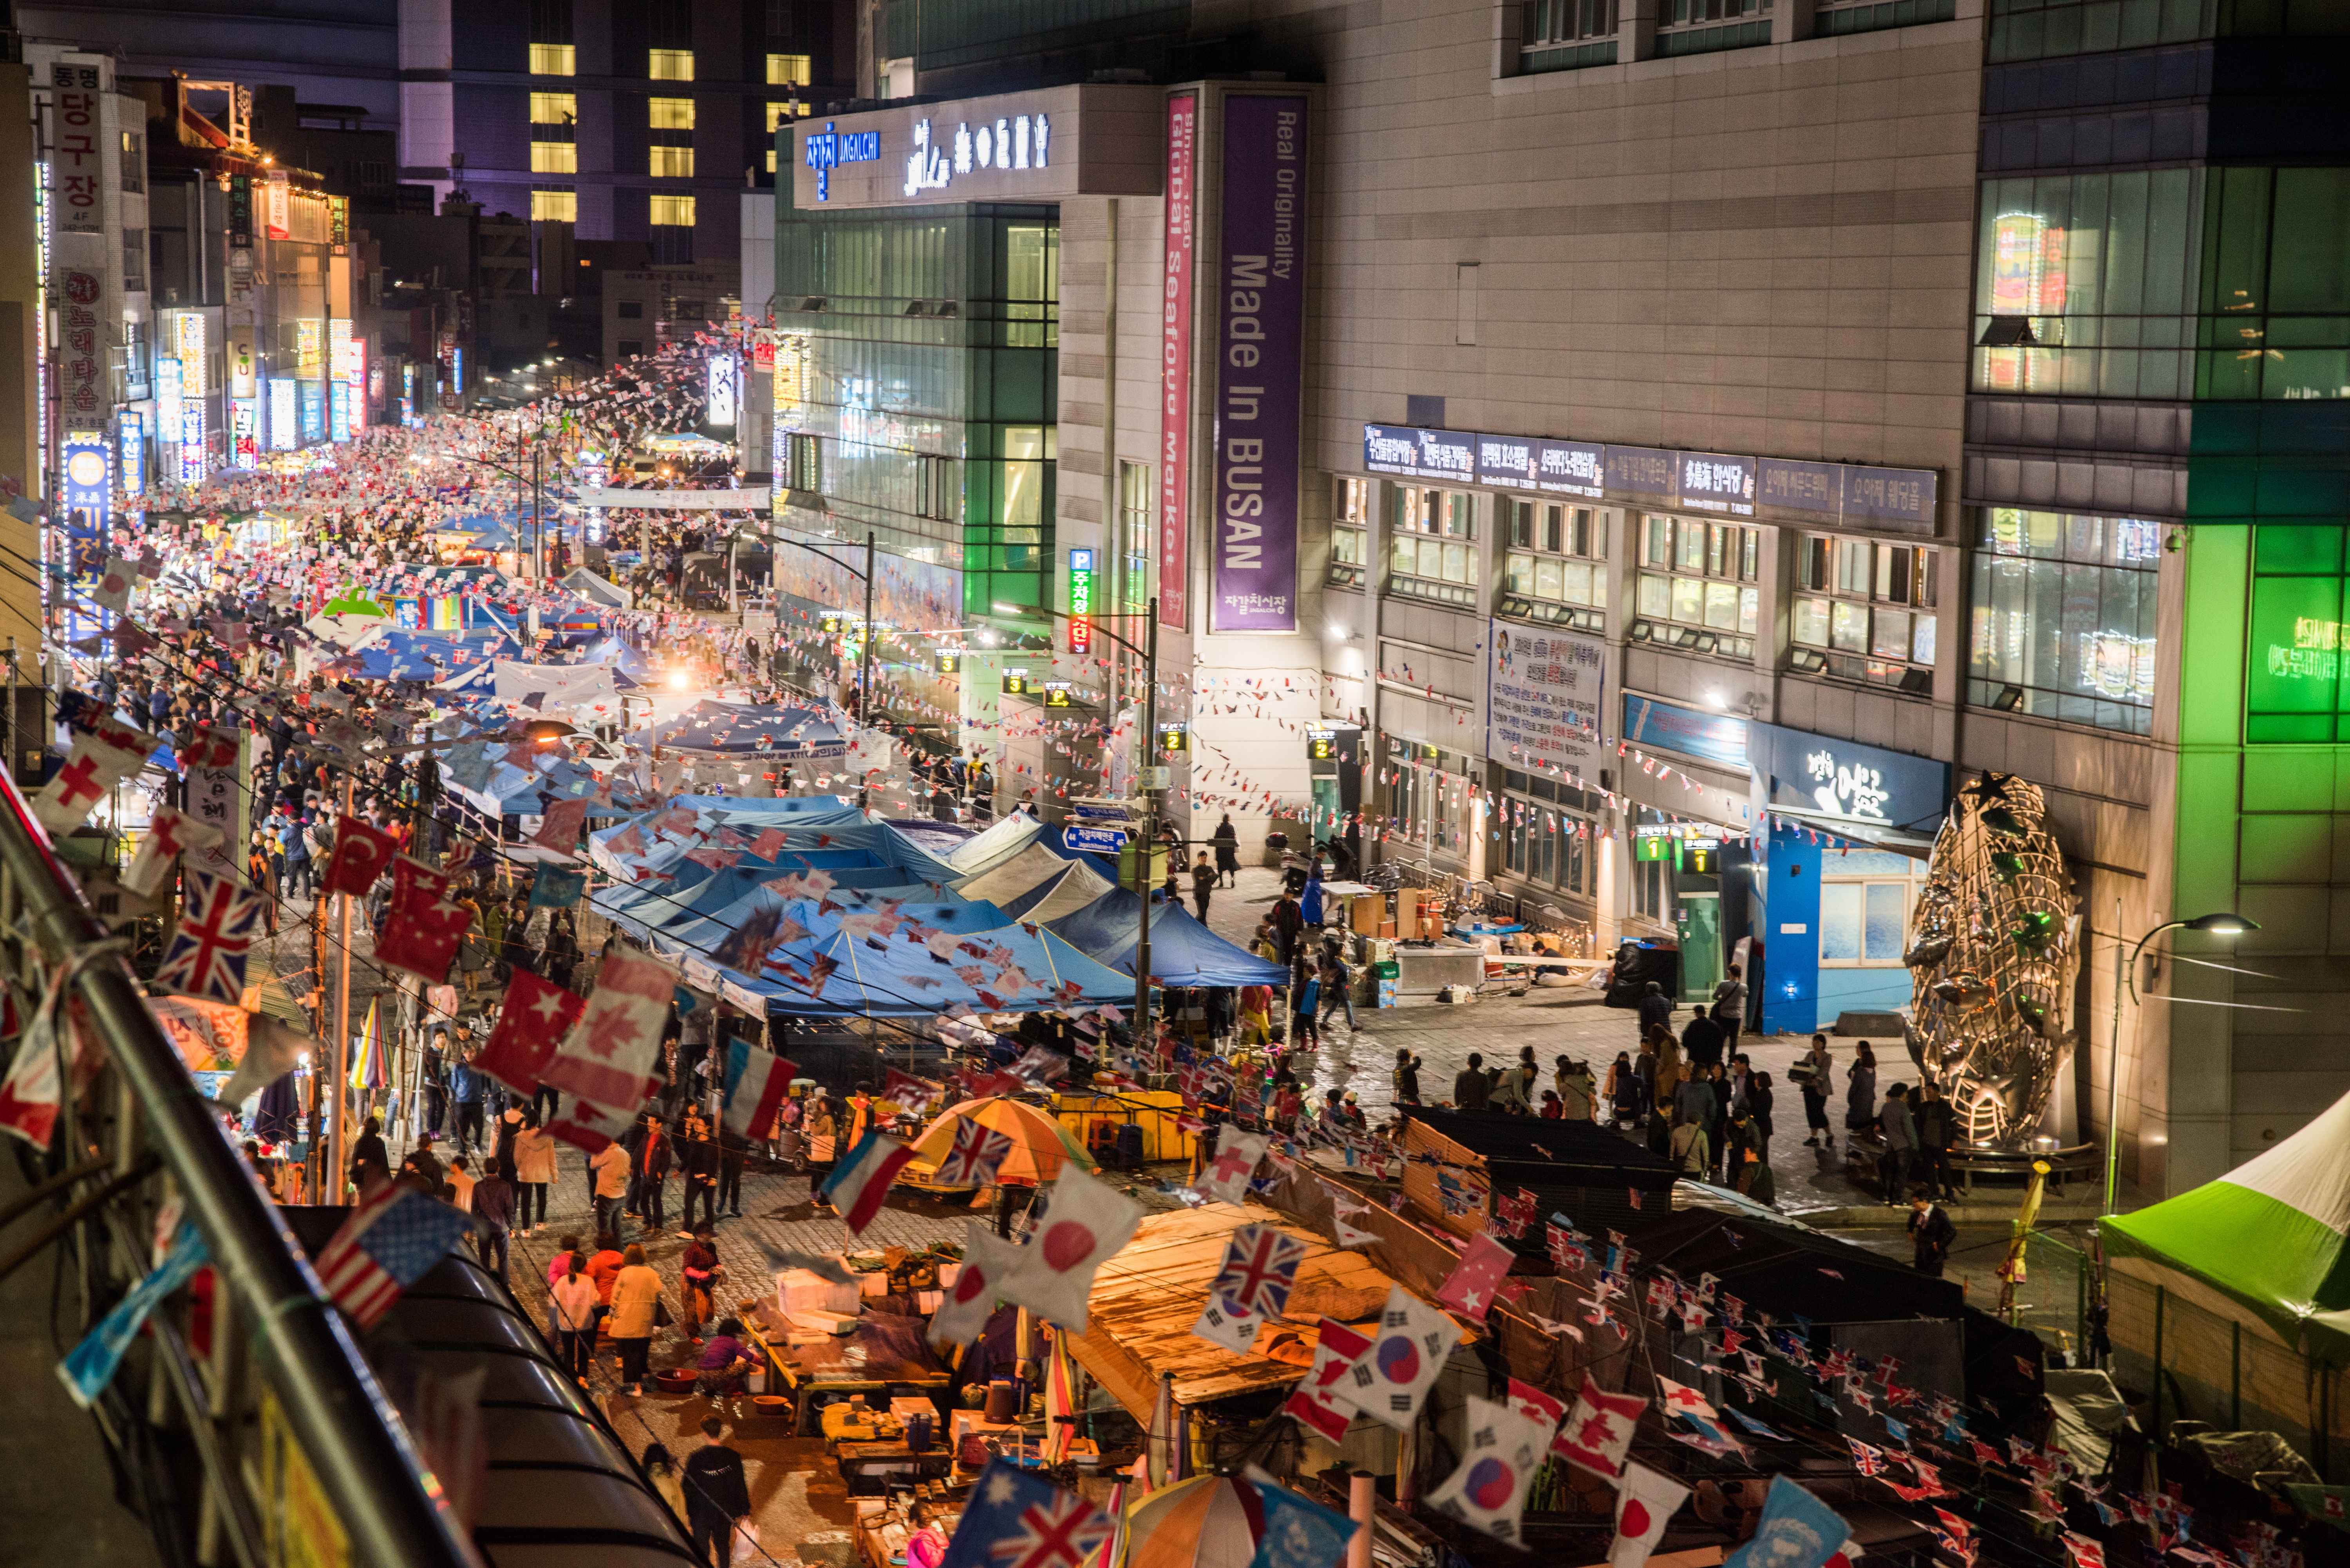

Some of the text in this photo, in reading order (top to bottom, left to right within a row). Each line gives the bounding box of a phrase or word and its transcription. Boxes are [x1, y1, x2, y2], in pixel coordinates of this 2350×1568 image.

[61, 93, 98, 208] 당구장
[839, 131, 880, 163] JAGALCHI
[1170, 114, 1183, 235] Global
[1272, 111, 1297, 280] Real Originality
[1229, 255, 1268, 368] Made
[1713, 463, 1743, 494] 한식당
[1165, 432, 1177, 568] Market
[1224, 437, 1263, 570] BUSAN
[1076, 552, 1089, 568] P
[1073, 571, 1089, 614] 주차장
[1225, 593, 1287, 615] 자갈치시장
[942, 659, 953, 672] 3
[1009, 679, 1021, 692] 3
[1053, 690, 1065, 703] P
[1167, 735, 1179, 750] 2
[1316, 743, 1328, 759] 2
[1078, 829, 1114, 842] 자갈치해안로
[1649, 842, 1658, 858] 1
[1694, 855, 1705, 872] 1
